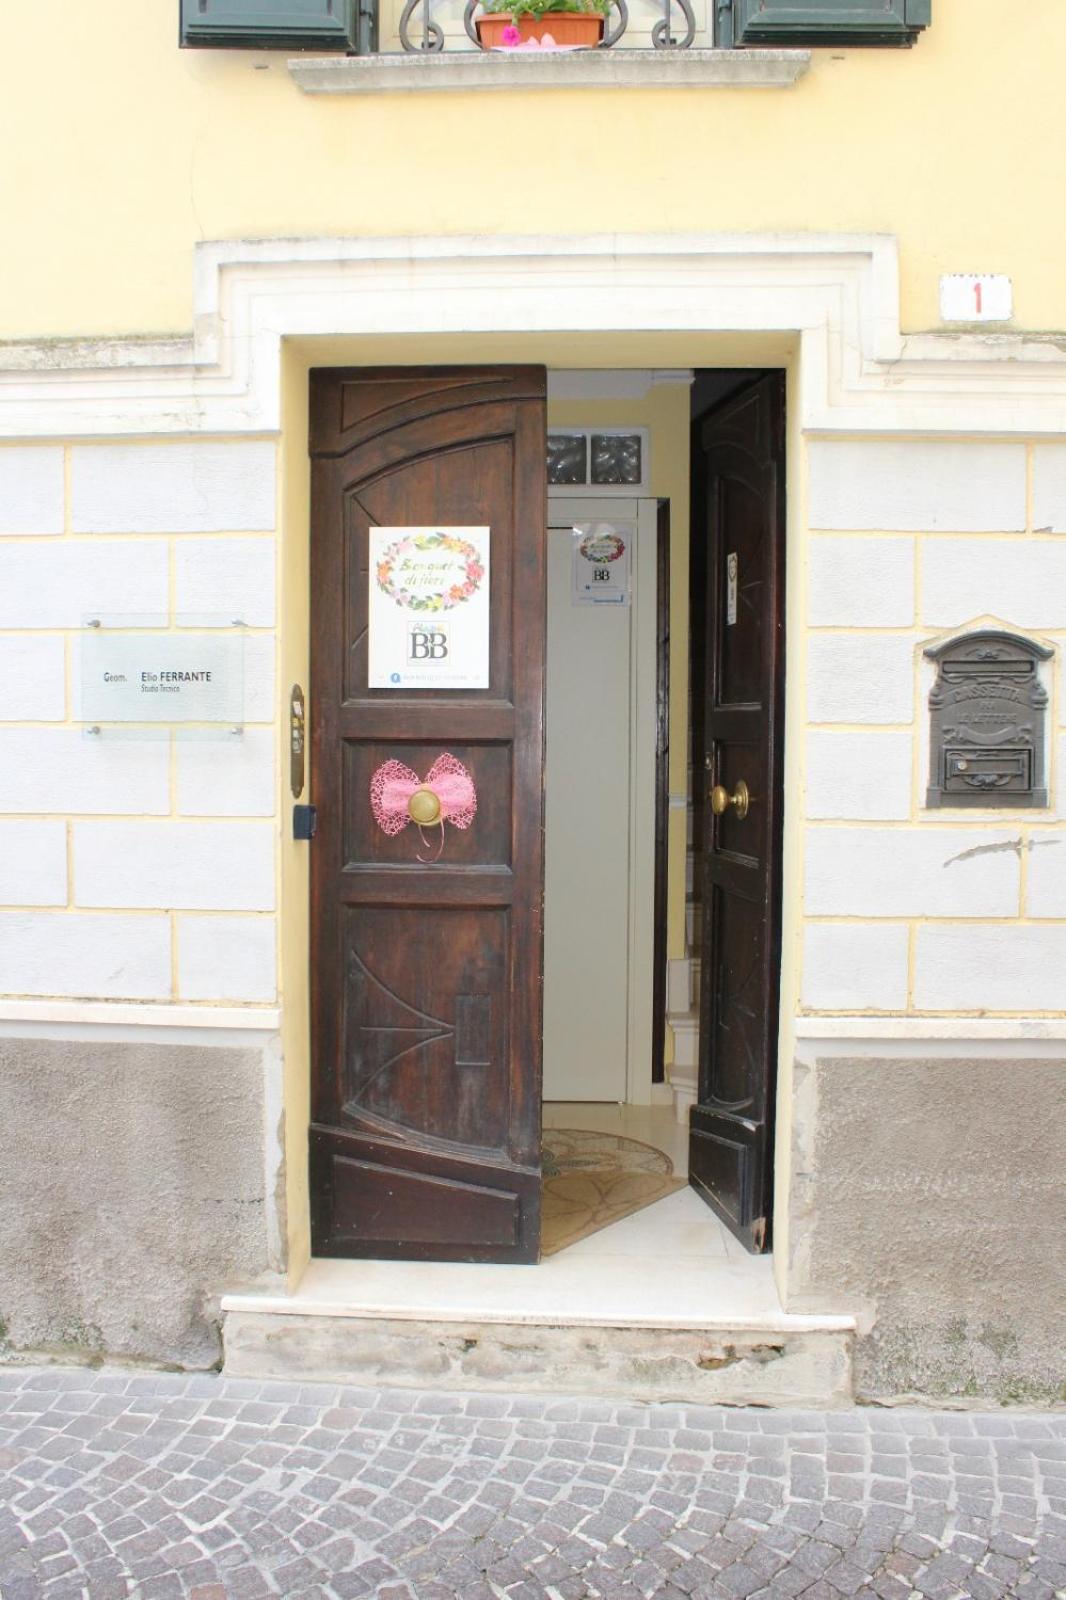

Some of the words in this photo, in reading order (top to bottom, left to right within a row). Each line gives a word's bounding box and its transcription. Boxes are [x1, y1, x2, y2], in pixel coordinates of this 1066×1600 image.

[974, 282, 982, 314] 1
[103, 672, 127, 682] Geom.
[141, 672, 157, 682] Elio
[160, 671, 212, 682] FERRANTE
[141, 684, 159, 693] Studio
[160, 683, 180, 693] Tecnico
